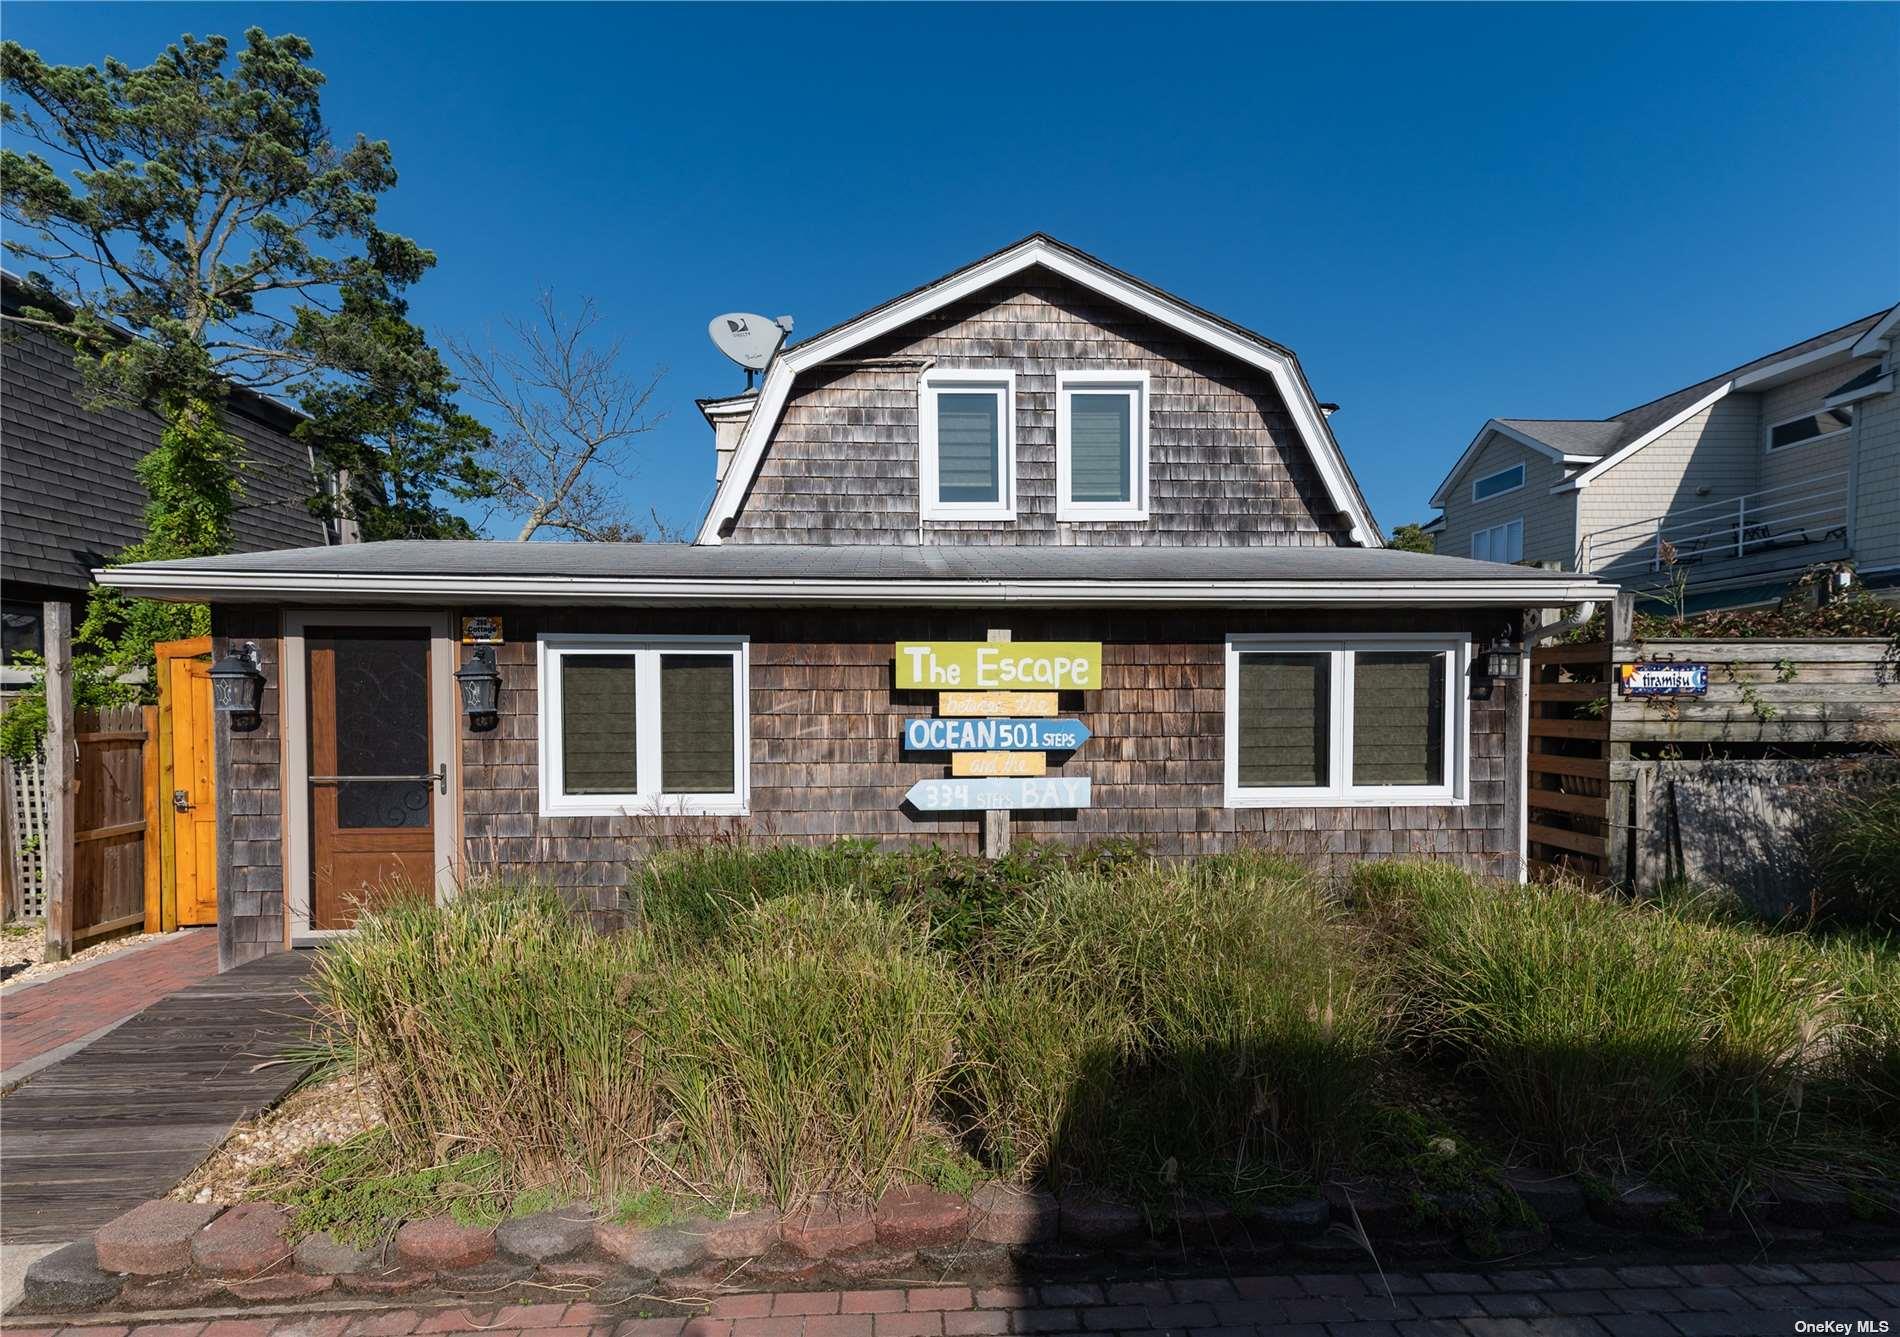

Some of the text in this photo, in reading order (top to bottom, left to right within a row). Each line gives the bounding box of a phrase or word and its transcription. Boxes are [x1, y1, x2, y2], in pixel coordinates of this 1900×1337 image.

[904, 646, 1089, 689] The Escape
[1642, 672, 1690, 687] tiramisu
[909, 719, 1076, 749] OCEAN 501 STEPS
[925, 783, 969, 808] 334
[1021, 781, 1081, 808] BAY
